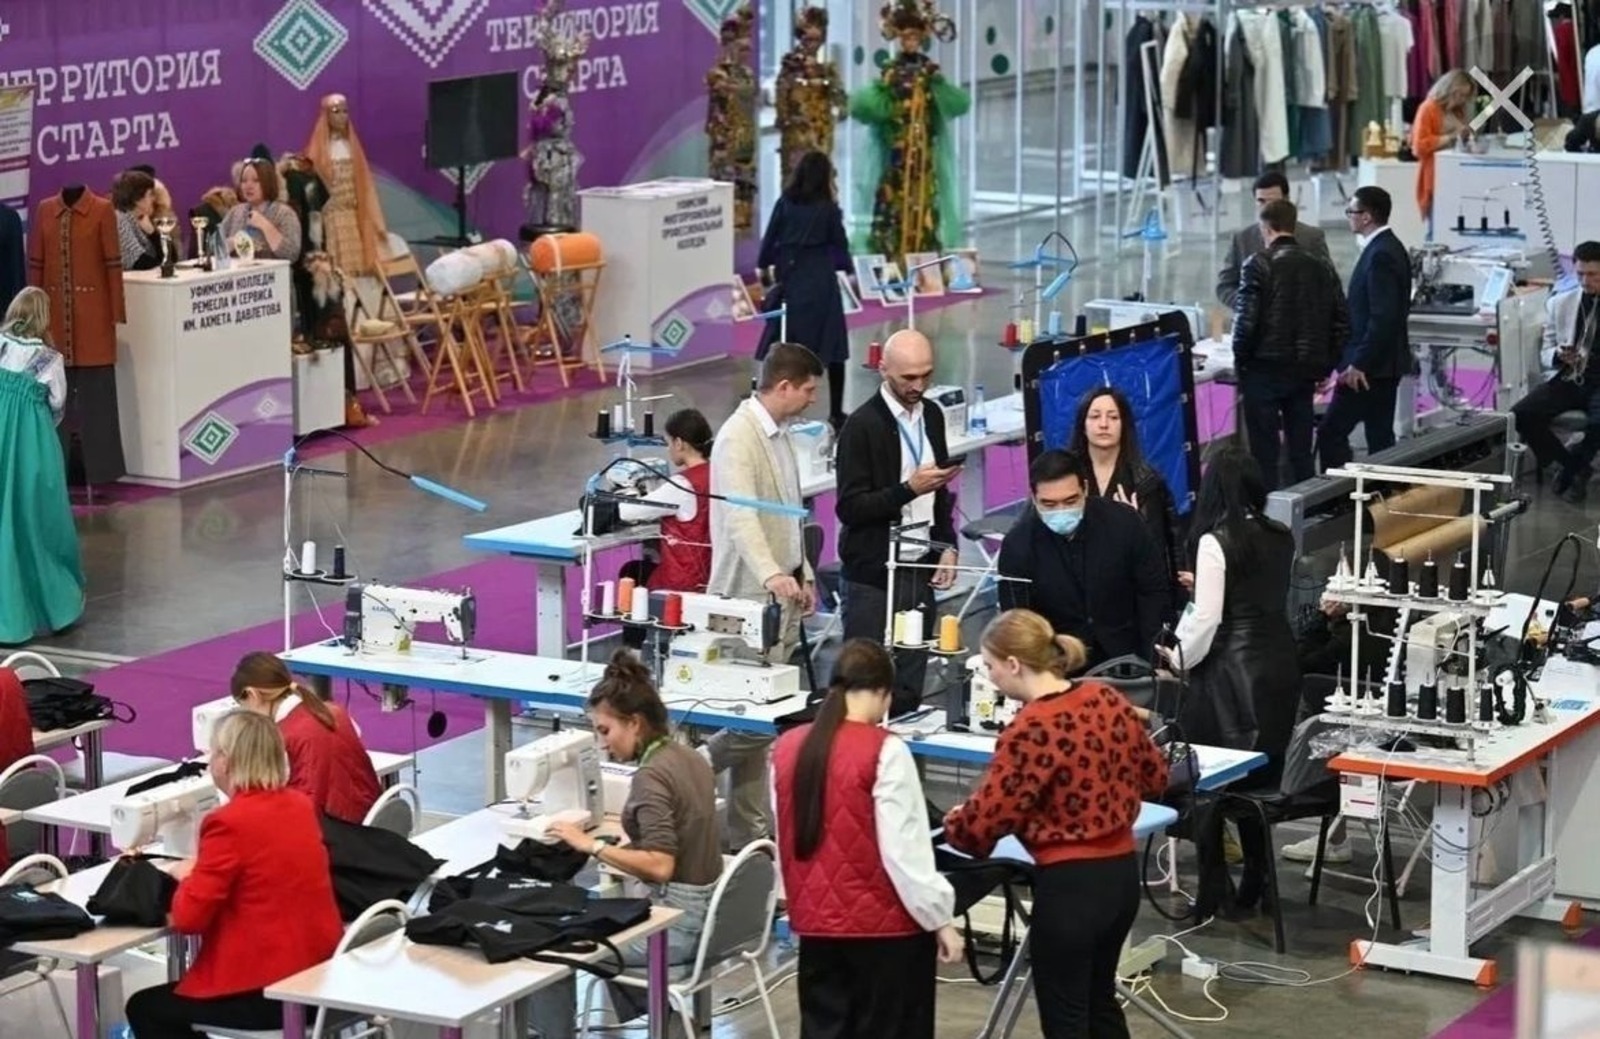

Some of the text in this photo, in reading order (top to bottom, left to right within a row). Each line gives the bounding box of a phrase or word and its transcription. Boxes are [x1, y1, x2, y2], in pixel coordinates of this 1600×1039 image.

[37, 111, 180, 165] СТАРТА
[190, 278, 234, 299] УФИМСКИЙ
[192, 287, 273, 314] РЕМЕСЛА И СЕРВИСА
[183, 301, 282, 332] ИМ. АХМЕТА ДАВЛЕТОВА
